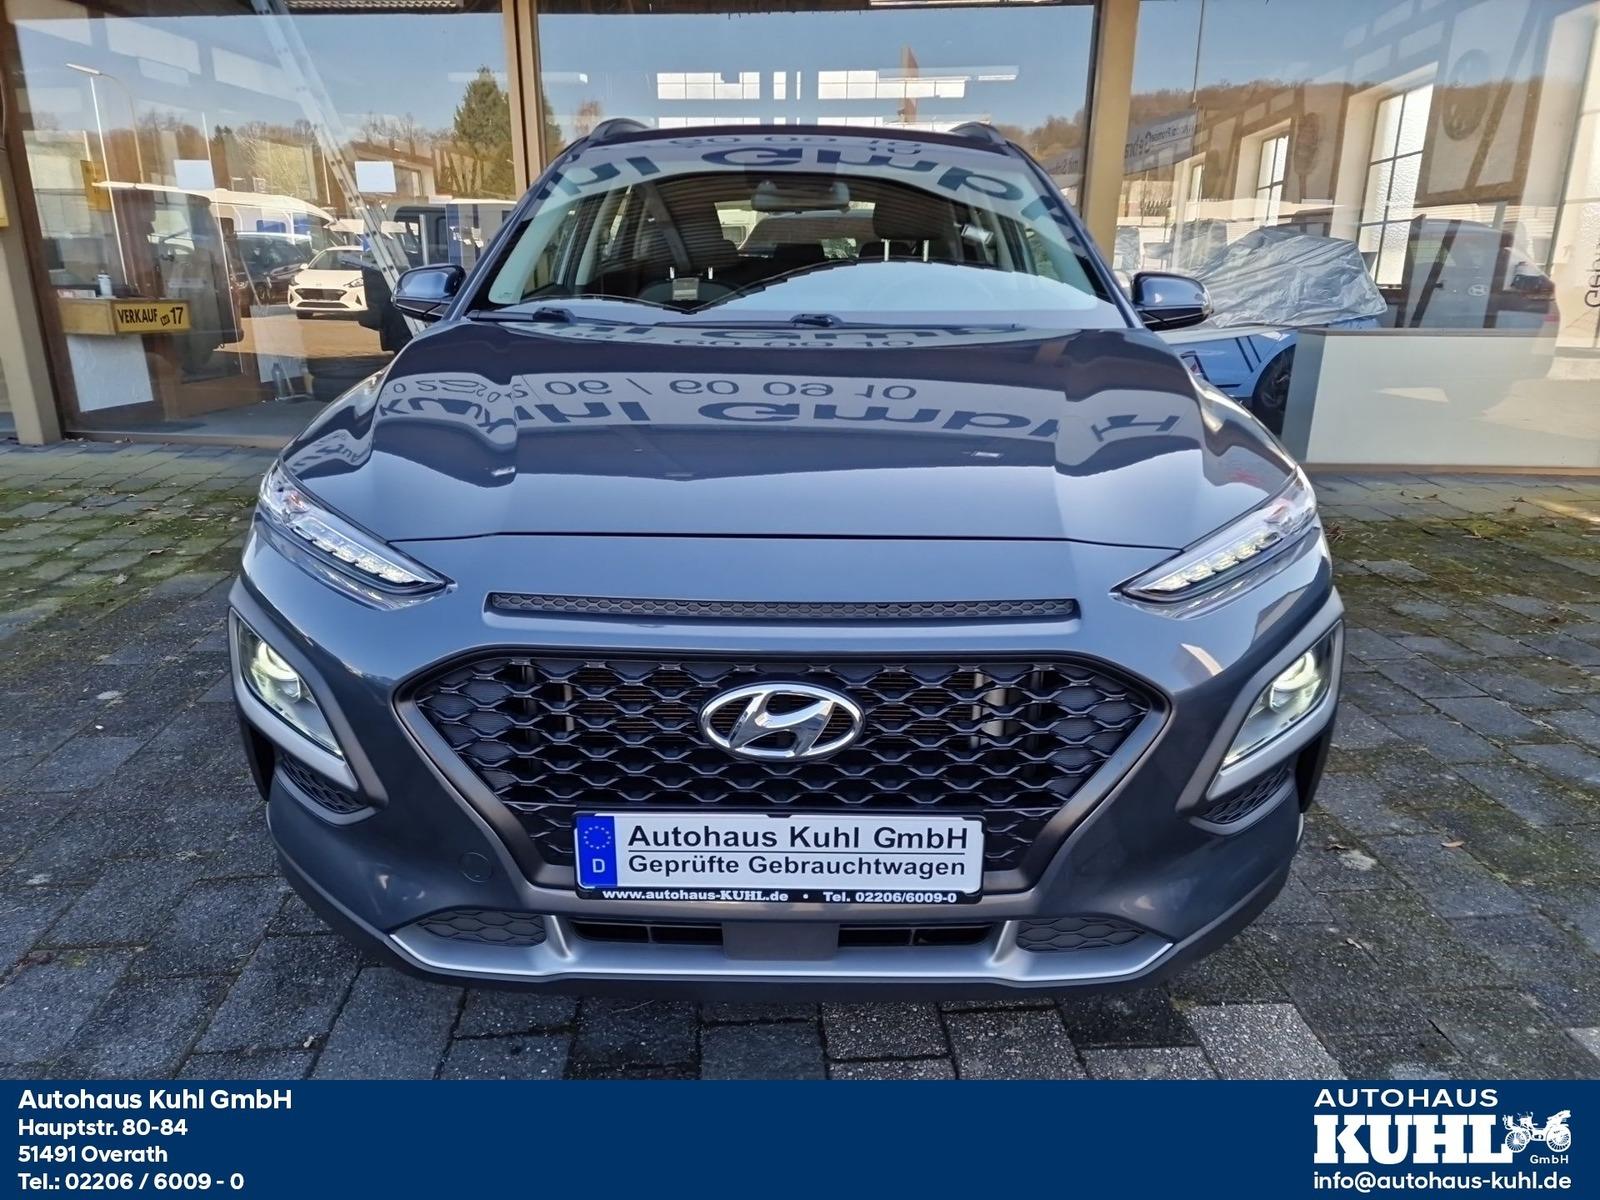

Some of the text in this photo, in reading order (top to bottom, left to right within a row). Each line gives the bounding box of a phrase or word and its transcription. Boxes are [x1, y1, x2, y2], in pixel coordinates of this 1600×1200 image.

[117, 308, 158, 324] VERKAUF
[170, 306, 184, 325] 17
[627, 825, 968, 850] Autohaus Kuhl GmbH
[592, 858, 606, 873] D
[628, 854, 966, 880] Geprüfte Gebrauchtwagen
[602, 888, 957, 904] www.autohaus-KUHL.de Tel. 02206/6009-0
